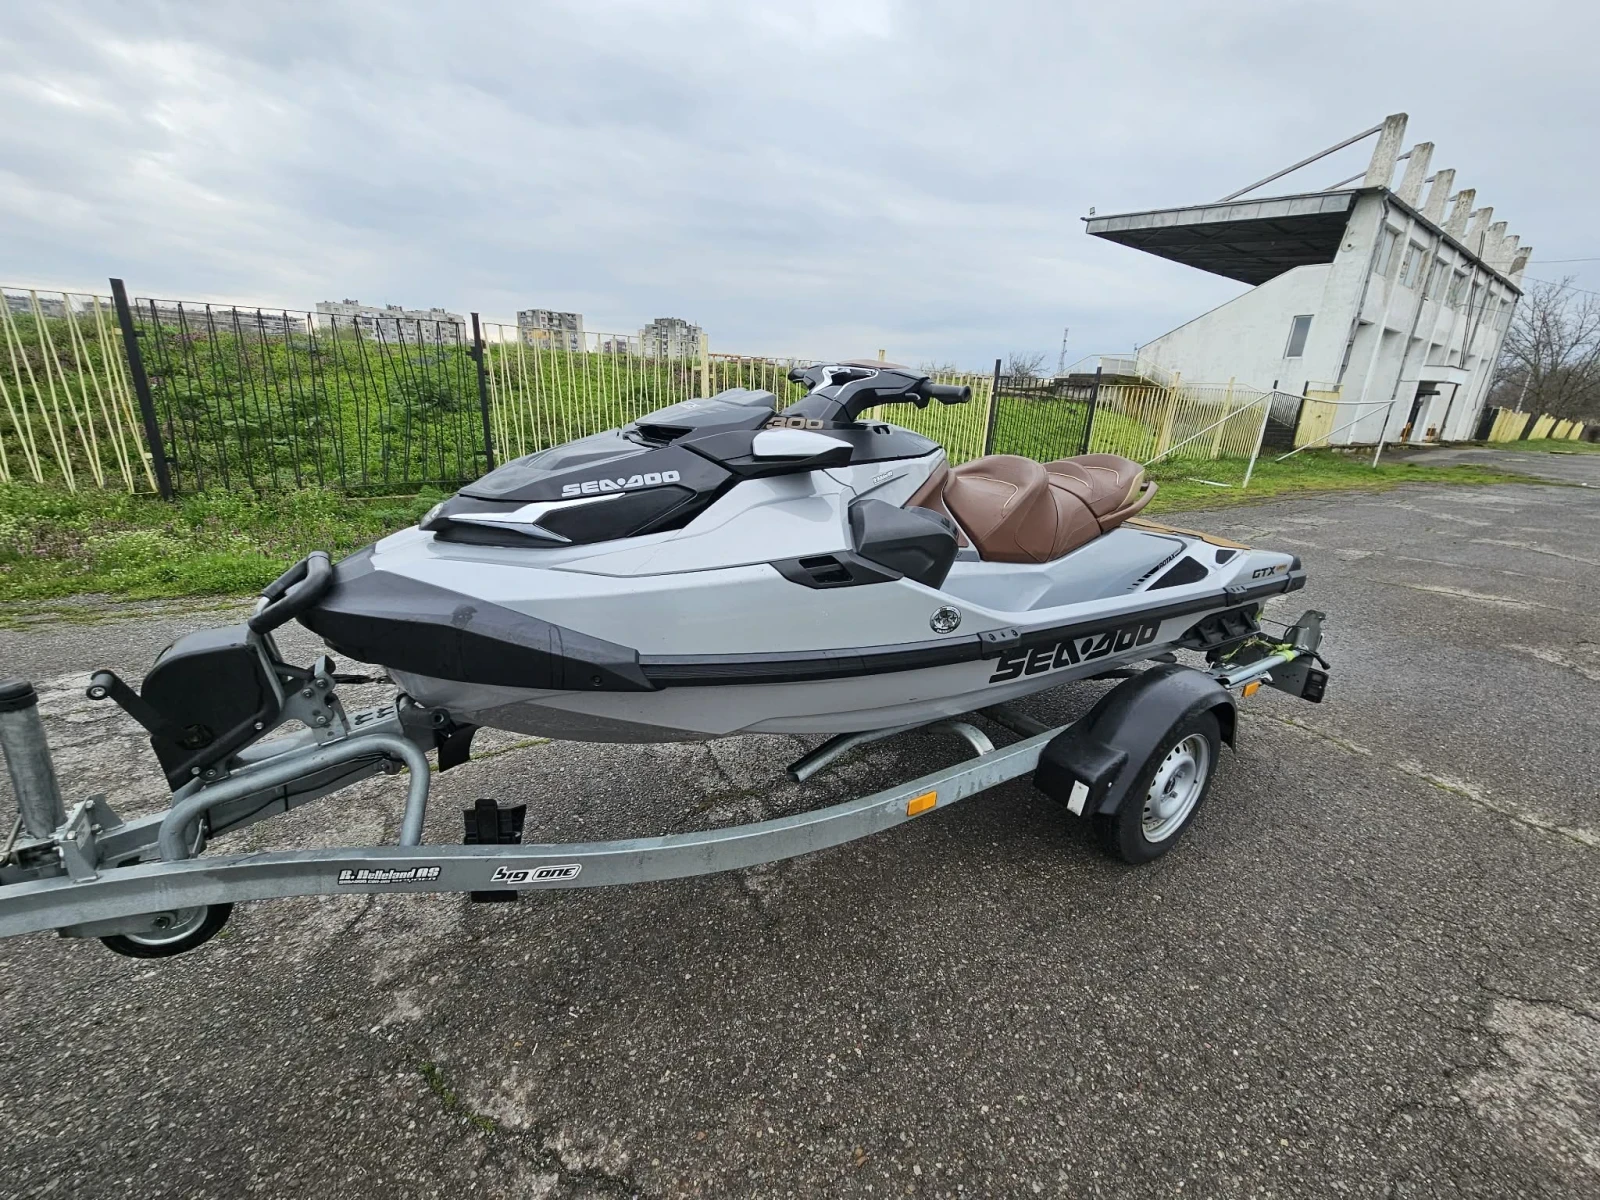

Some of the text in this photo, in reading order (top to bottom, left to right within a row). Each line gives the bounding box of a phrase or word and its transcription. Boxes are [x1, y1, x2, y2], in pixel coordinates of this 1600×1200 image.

[766, 416, 824, 430] 300
[1158, 553, 1176, 569] ROTAX
[1252, 565, 1276, 579] GTX
[356, 868, 417, 880] Helleland
[415, 866, 441, 879] AS
